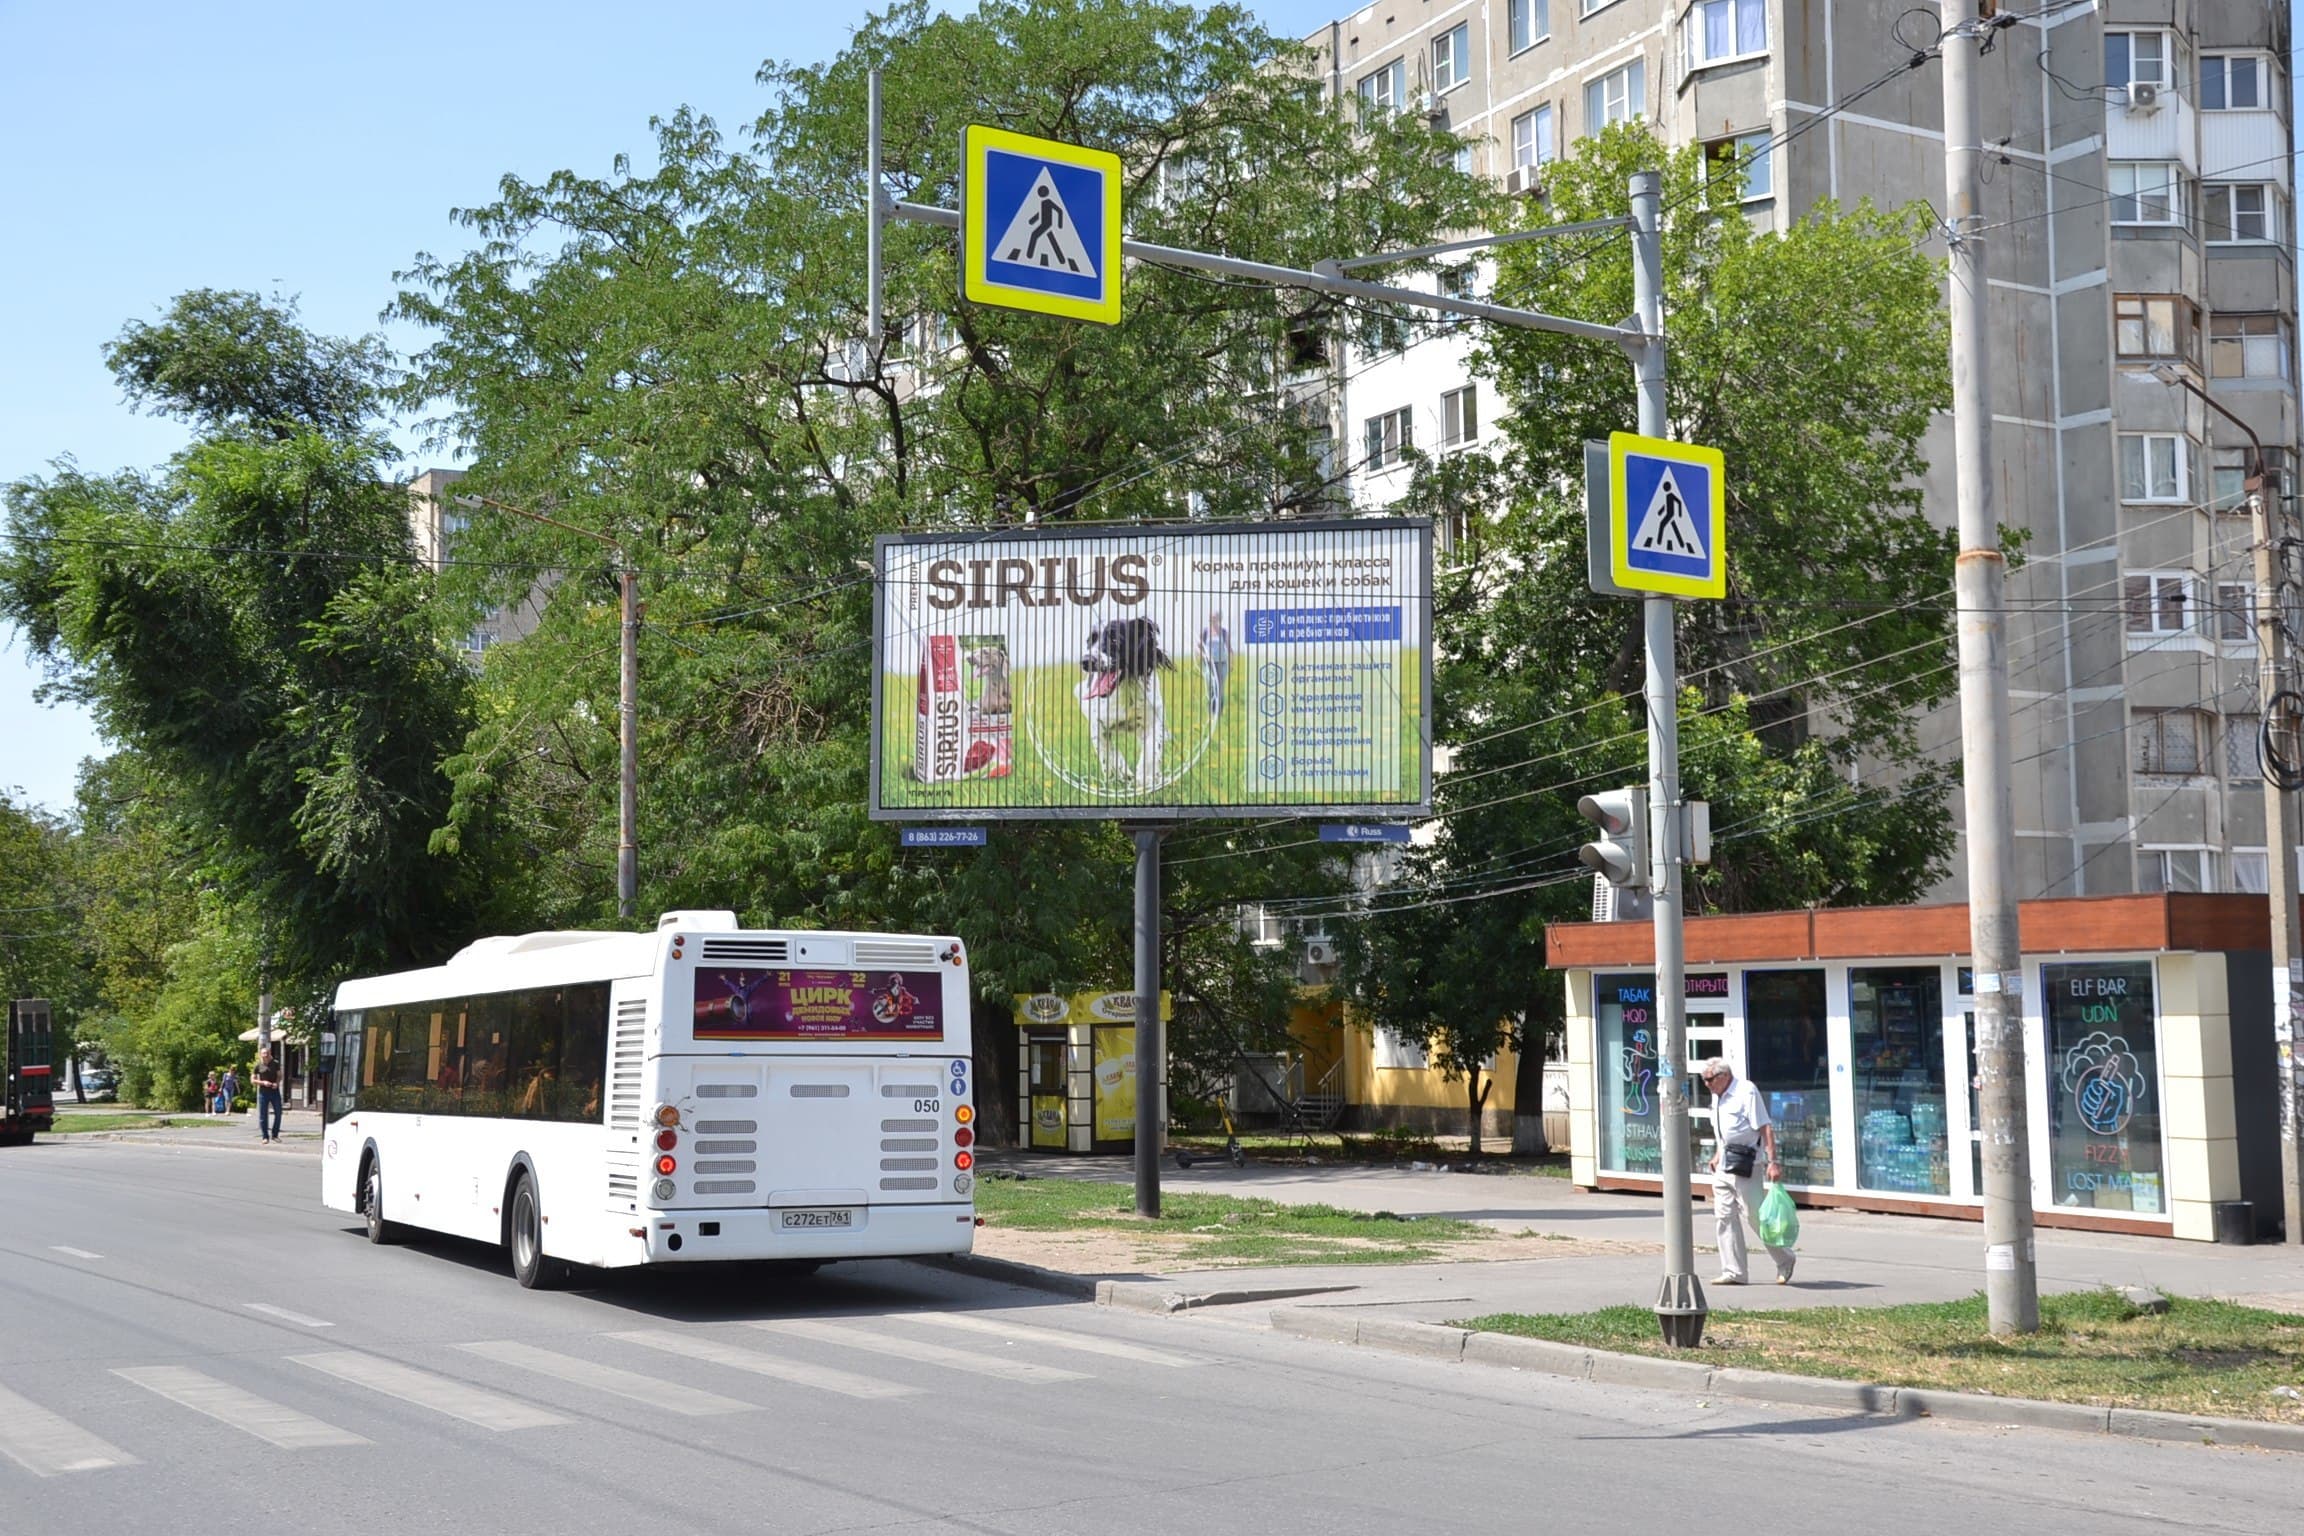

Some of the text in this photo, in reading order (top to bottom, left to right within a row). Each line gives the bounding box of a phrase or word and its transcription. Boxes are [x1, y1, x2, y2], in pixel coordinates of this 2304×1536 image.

[1192, 557, 1391, 575] Корма премиум-класса
[927, 555, 1150, 610] SIRIUS
[1230, 574, 1391, 591] для кошек и собак
[1280, 613, 1328, 625] Комплекс
[1291, 662, 1392, 672] Активная защита
[1291, 676, 1353, 685] организма
[1291, 693, 1363, 703] Укрепление
[1291, 705, 1363, 715] иммунитета
[936, 699, 959, 776] SIRIUS
[1291, 726, 1358, 736] Улучшение
[1291, 737, 1373, 747] пищеварения
[1300, 769, 1369, 778] патогенами
[909, 831, 979, 843] 8 (863) 226-77-26
[1361, 827, 1382, 836] Russ
[2071, 978, 2128, 996] ELF BAR
[791, 987, 853, 1006] ЦИРК
[1618, 988, 1650, 1003] ТАБАК
[1622, 1008, 1647, 1023] HQD
[2081, 1004, 2118, 1023] UDN
[914, 1099, 940, 1113] 050
